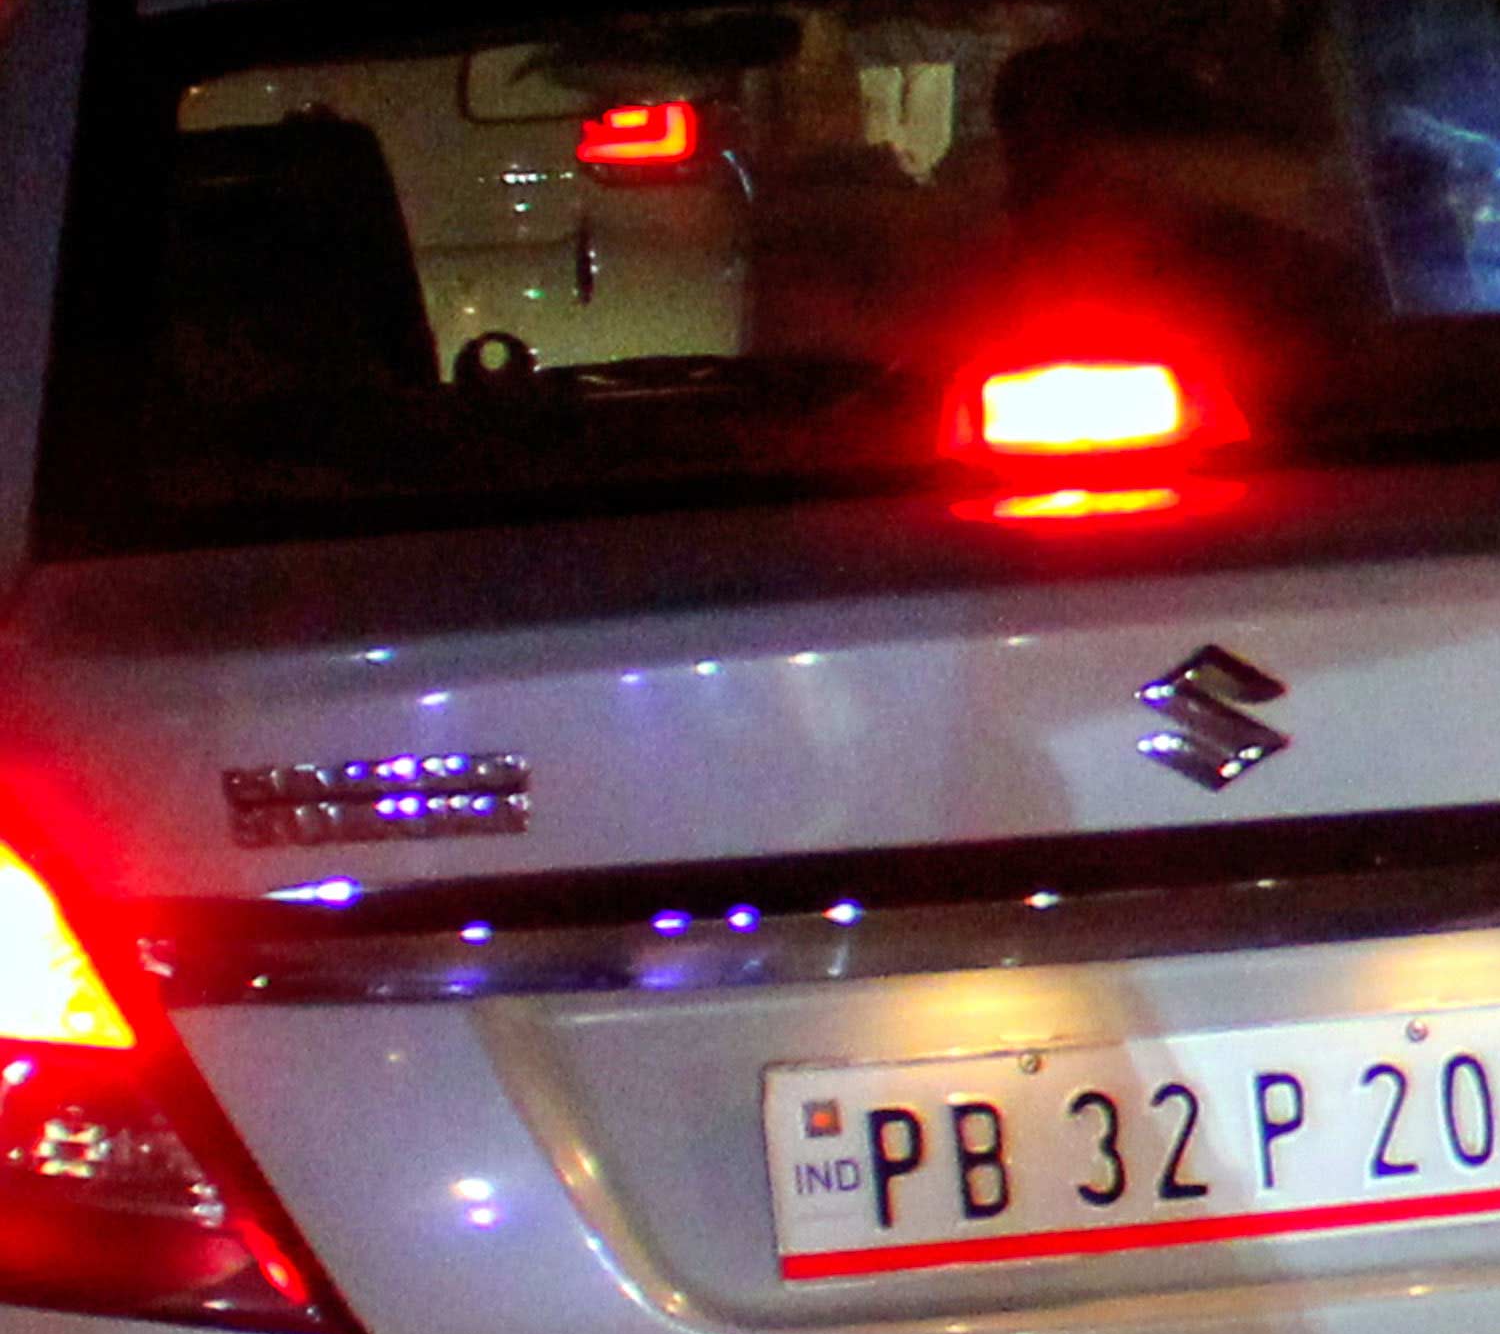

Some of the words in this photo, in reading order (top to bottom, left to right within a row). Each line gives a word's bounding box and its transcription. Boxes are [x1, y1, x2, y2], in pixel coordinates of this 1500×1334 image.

[794, 1159, 862, 1196] IND
[864, 1101, 1011, 1229] PB
[1067, 1082, 1208, 1208] 32
[1252, 1070, 1306, 1190] P
